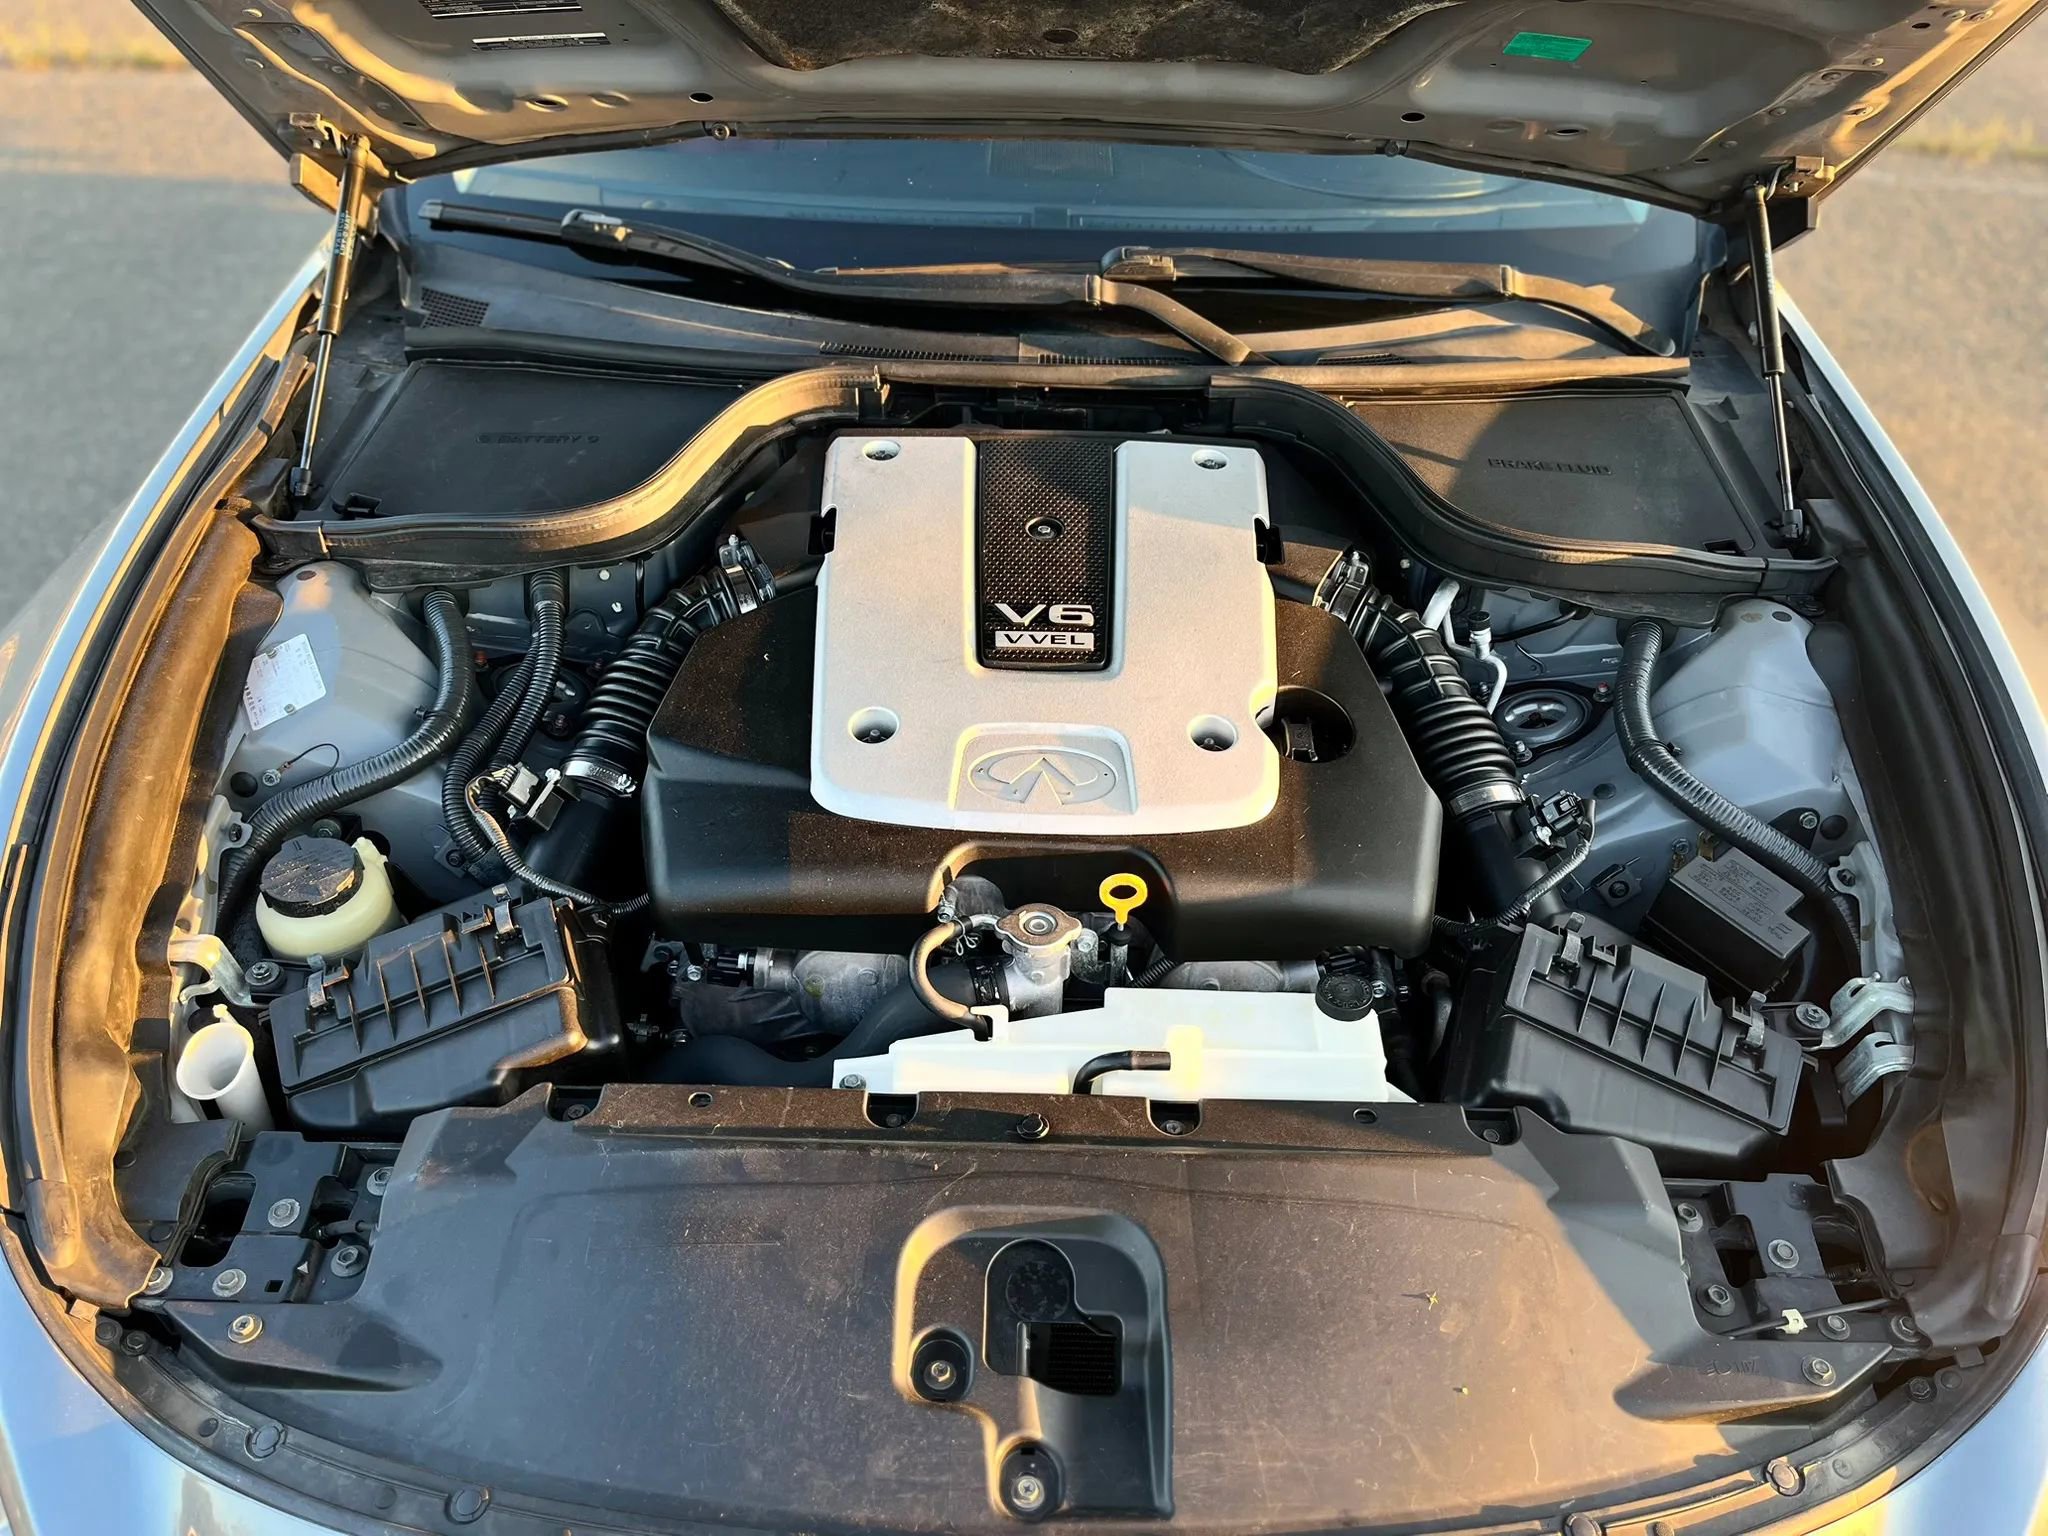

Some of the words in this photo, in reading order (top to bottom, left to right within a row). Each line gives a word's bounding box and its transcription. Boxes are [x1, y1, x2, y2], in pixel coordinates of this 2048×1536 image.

[1487, 458, 1554, 472] BRAKE
[1556, 462, 1612, 476] FLUID
[994, 603, 1094, 626] V6
[1003, 633, 1085, 645] VVEL
